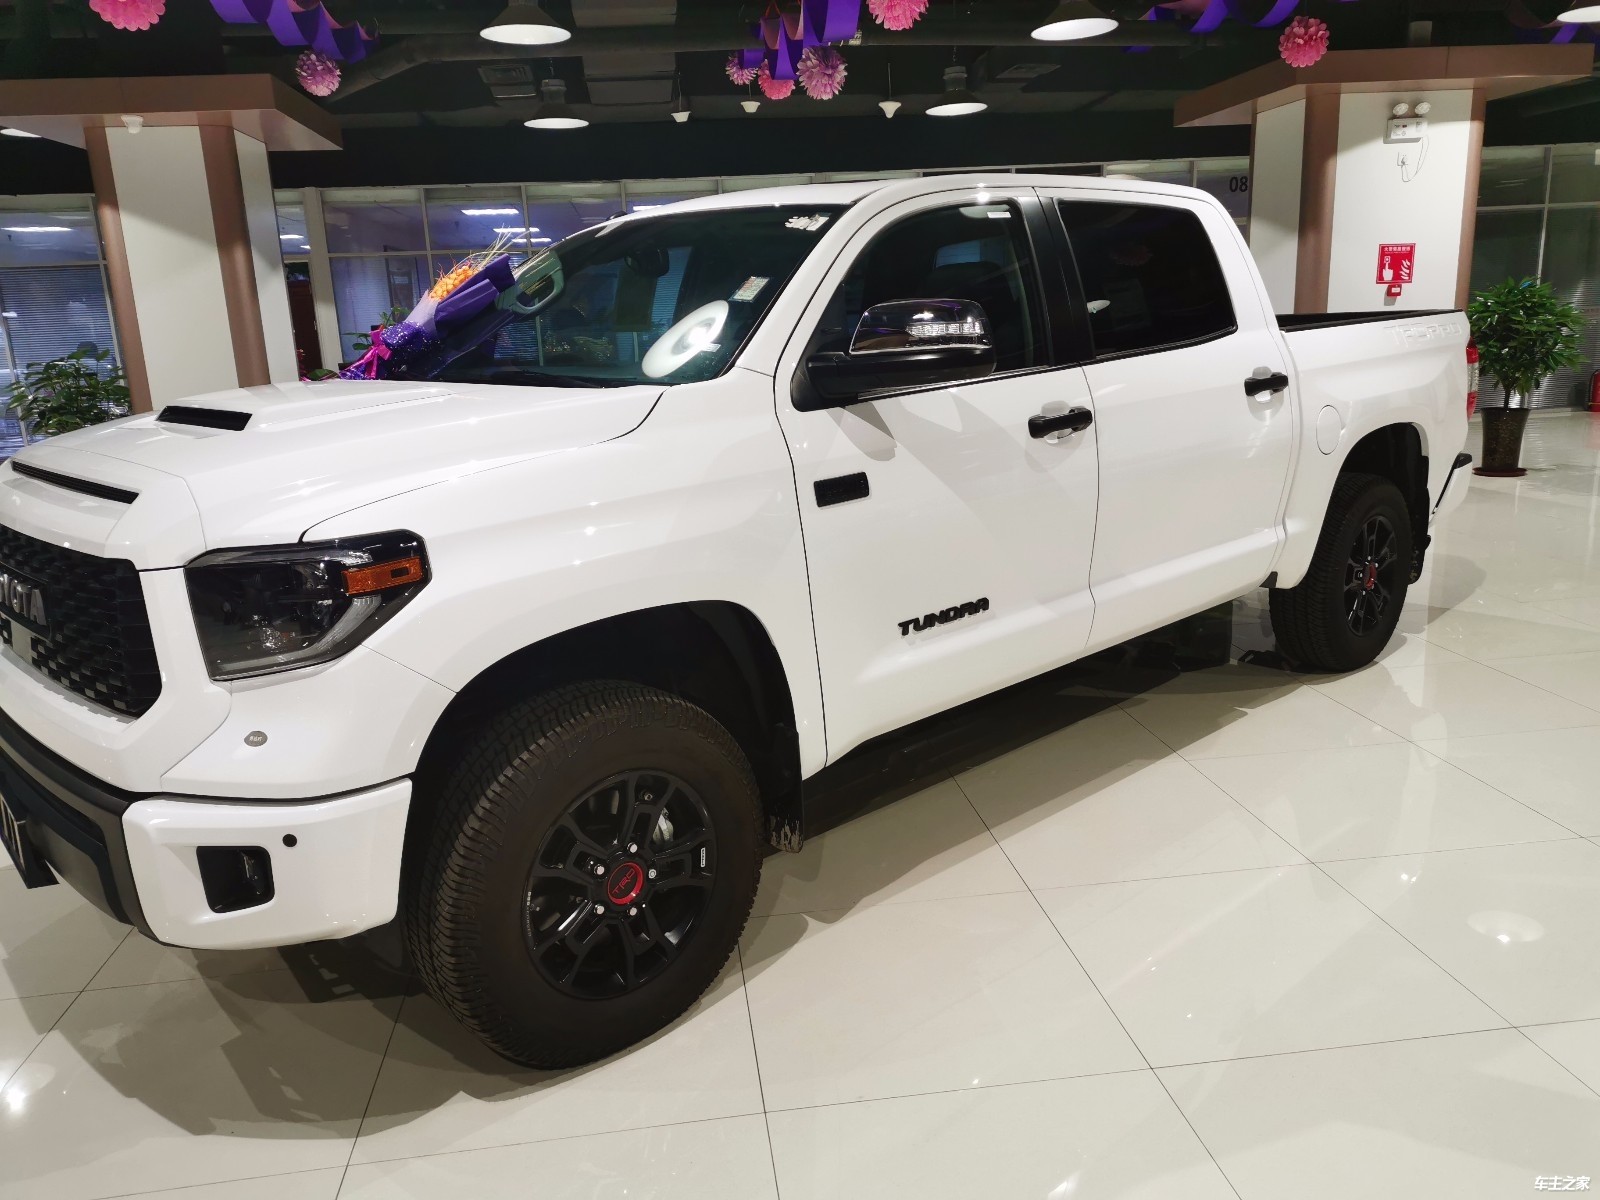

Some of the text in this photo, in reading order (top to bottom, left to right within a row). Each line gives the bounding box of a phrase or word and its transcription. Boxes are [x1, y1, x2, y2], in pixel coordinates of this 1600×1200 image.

[1229, 176, 1248, 192] 08
[898, 597, 990, 636] TUNDRA
[612, 868, 636, 894] TRD
